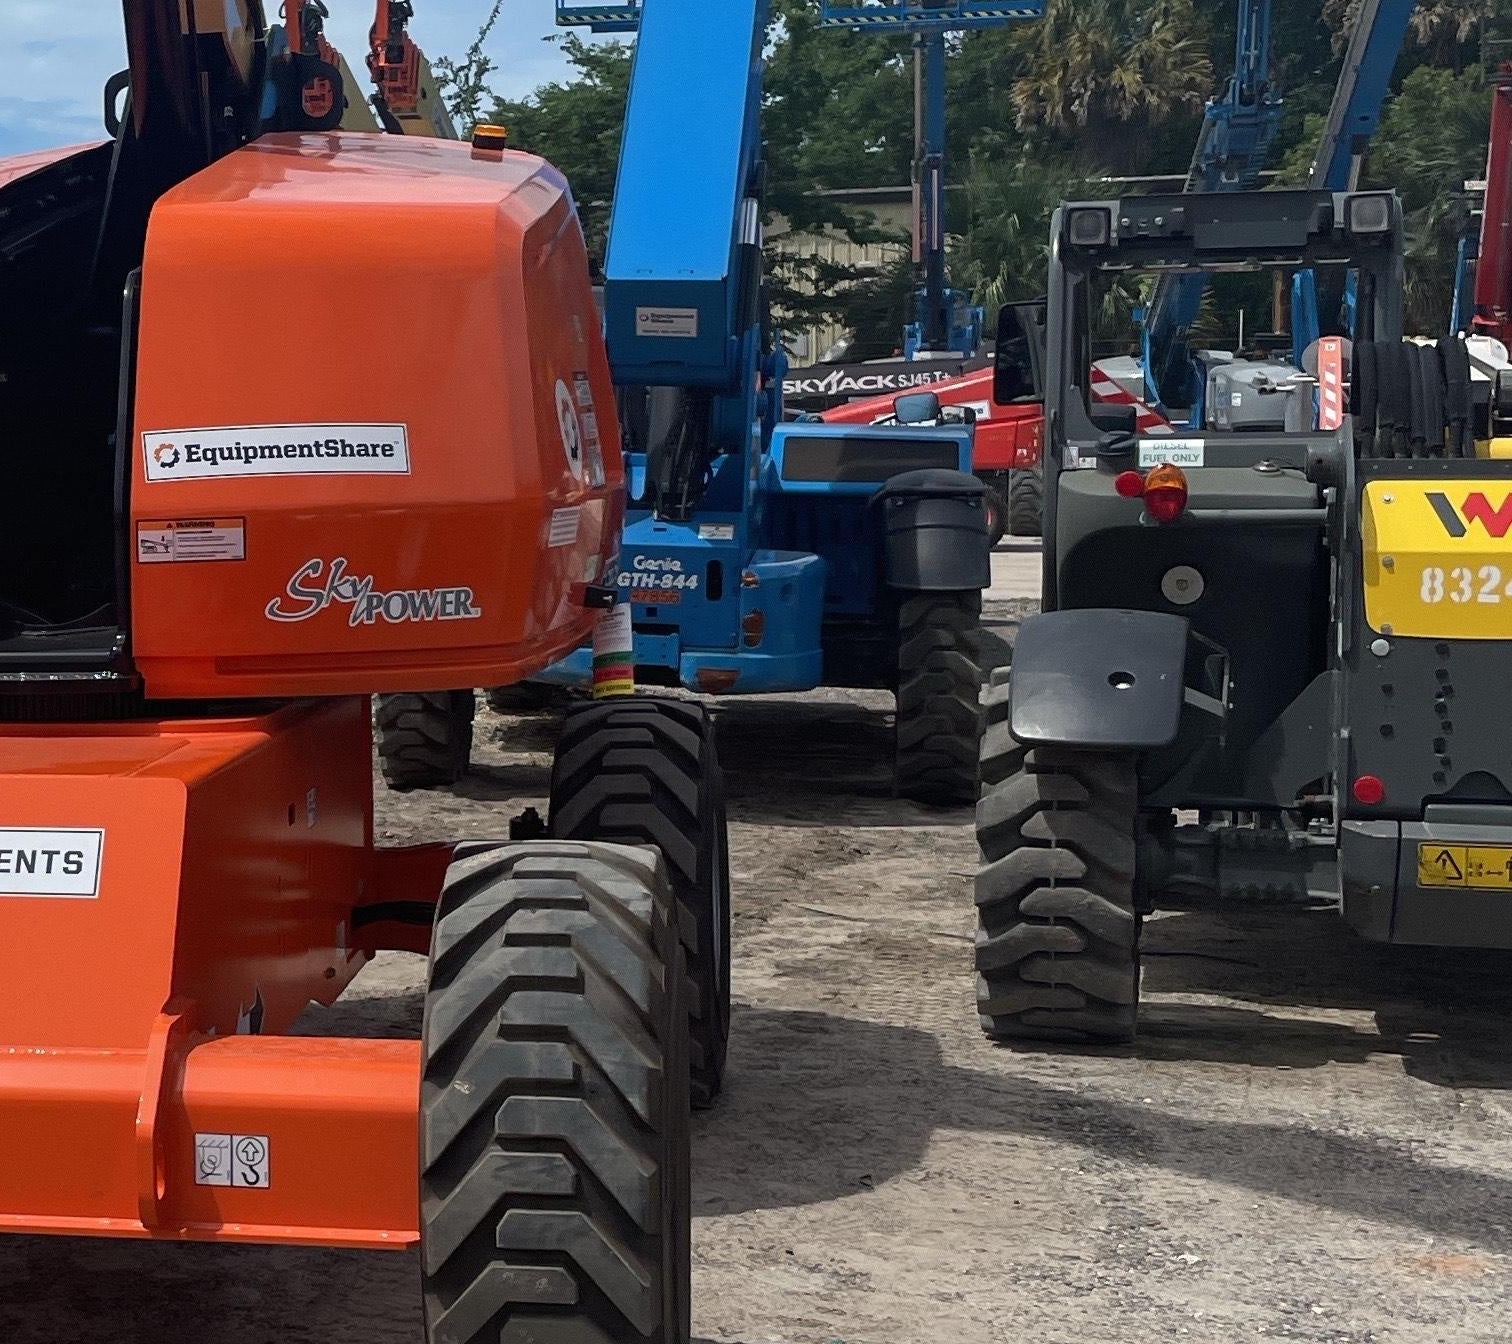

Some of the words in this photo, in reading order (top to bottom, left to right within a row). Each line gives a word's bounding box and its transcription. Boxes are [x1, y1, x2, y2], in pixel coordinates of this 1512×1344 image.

[782, 369, 899, 395] SKYJACK
[898, 373, 931, 388] SJ45
[184, 439, 395, 466] EquipmentShare
[1143, 454, 1168, 463] FUEL
[1172, 453, 1200, 463] ONLY
[633, 554, 682, 572] Genie
[616, 572, 698, 590] GTH-844
